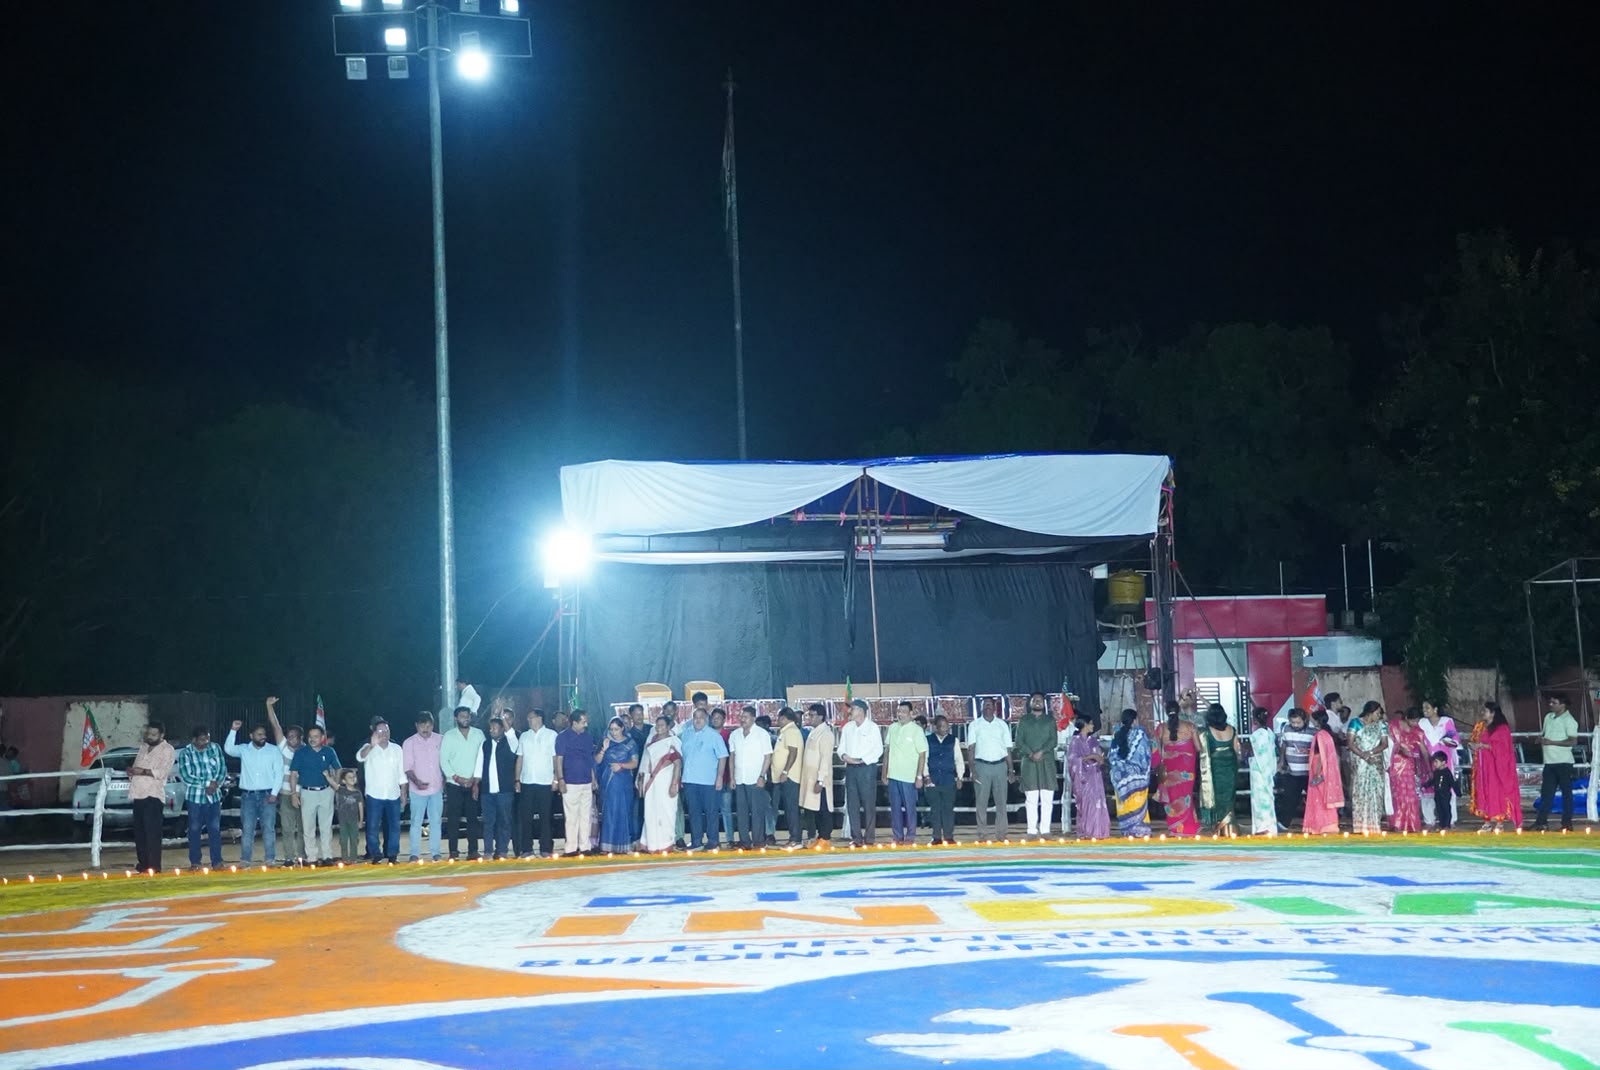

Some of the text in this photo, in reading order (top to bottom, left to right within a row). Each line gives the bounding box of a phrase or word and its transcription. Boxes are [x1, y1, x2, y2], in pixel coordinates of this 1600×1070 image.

[542, 892, 1600, 938] INDIA
[518, 950, 869, 968] BUILDING
[894, 947, 941, 955] A
[966, 937, 1360, 952] BRIGHTER
[671, 925, 1600, 952] EMPOWERING CITIZE
